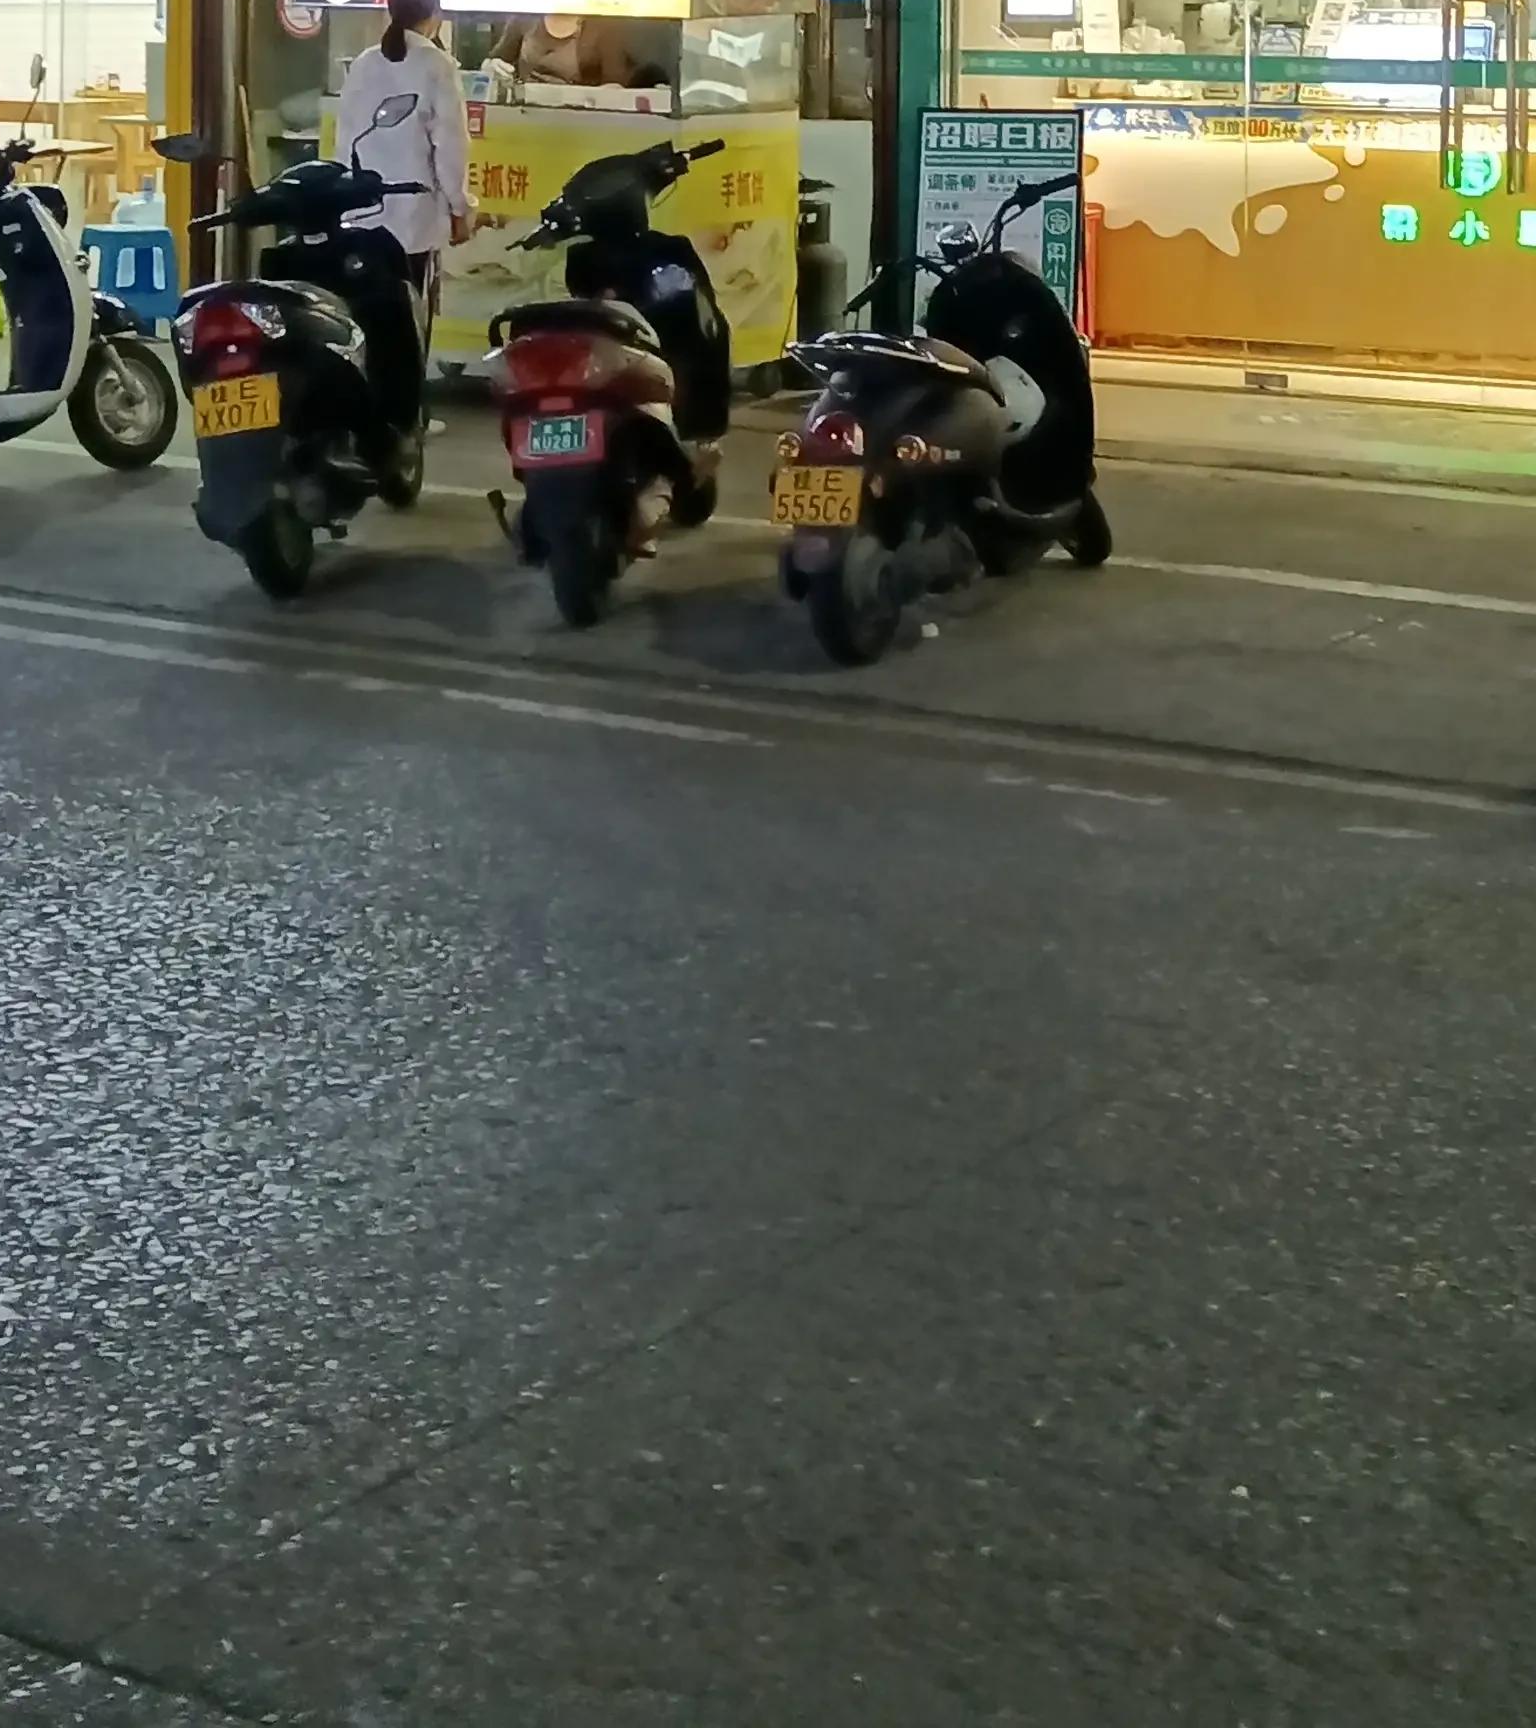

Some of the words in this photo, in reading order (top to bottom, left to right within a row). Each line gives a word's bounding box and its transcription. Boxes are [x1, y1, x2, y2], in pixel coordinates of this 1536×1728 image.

[926, 122, 1073, 150] 招聘日报
[721, 171, 764, 208] 手抓饼
[776, 493, 851, 523] 555C6
